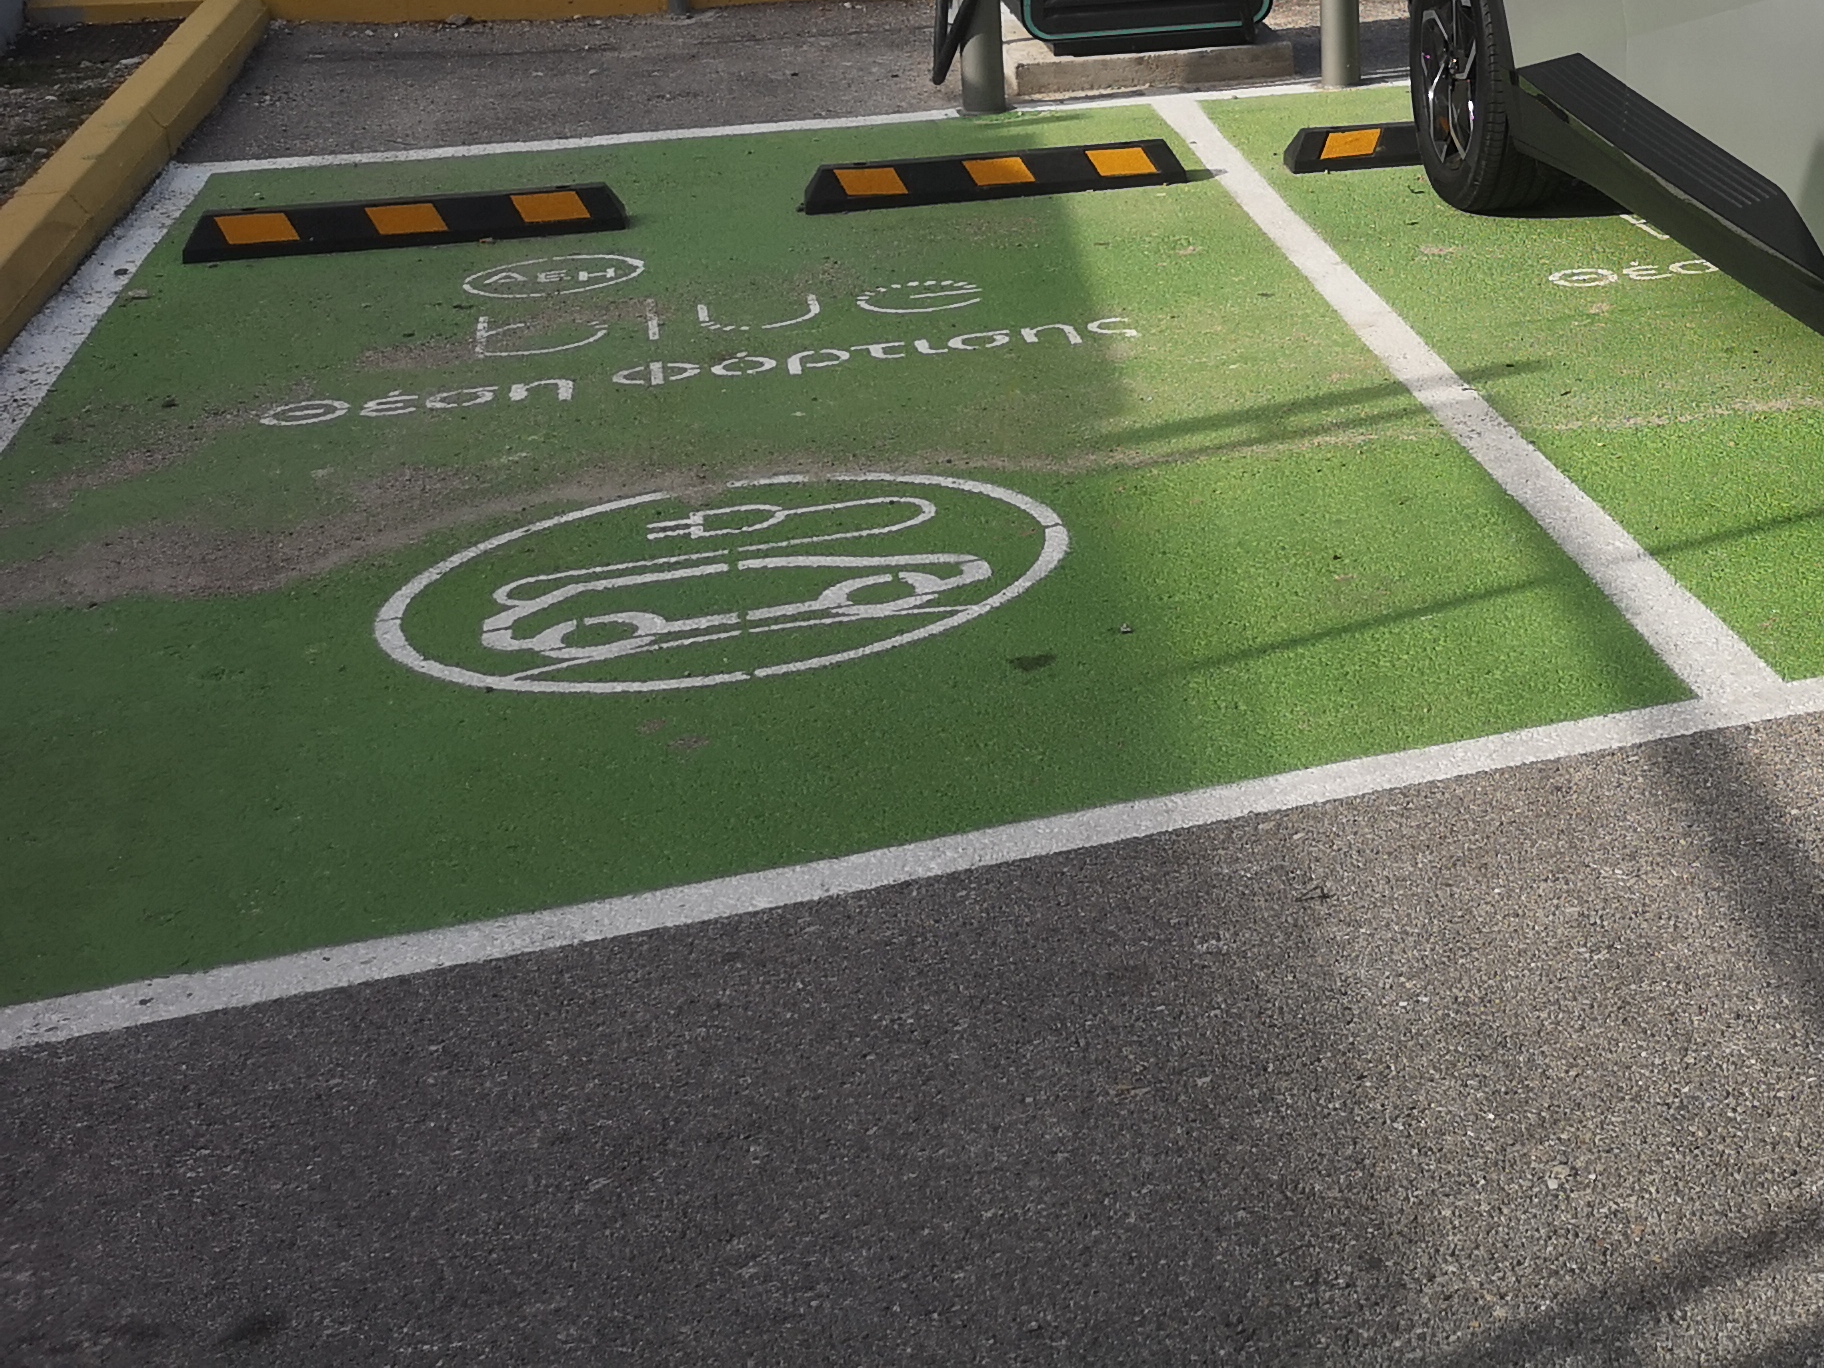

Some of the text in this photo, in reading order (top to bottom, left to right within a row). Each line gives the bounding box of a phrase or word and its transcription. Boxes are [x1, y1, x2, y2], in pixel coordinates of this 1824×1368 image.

[484, 267, 616, 284] ΔΕΗ
[1549, 258, 1719, 287] Θέσ
[476, 280, 982, 358] blue
[260, 378, 573, 426] Θέση
